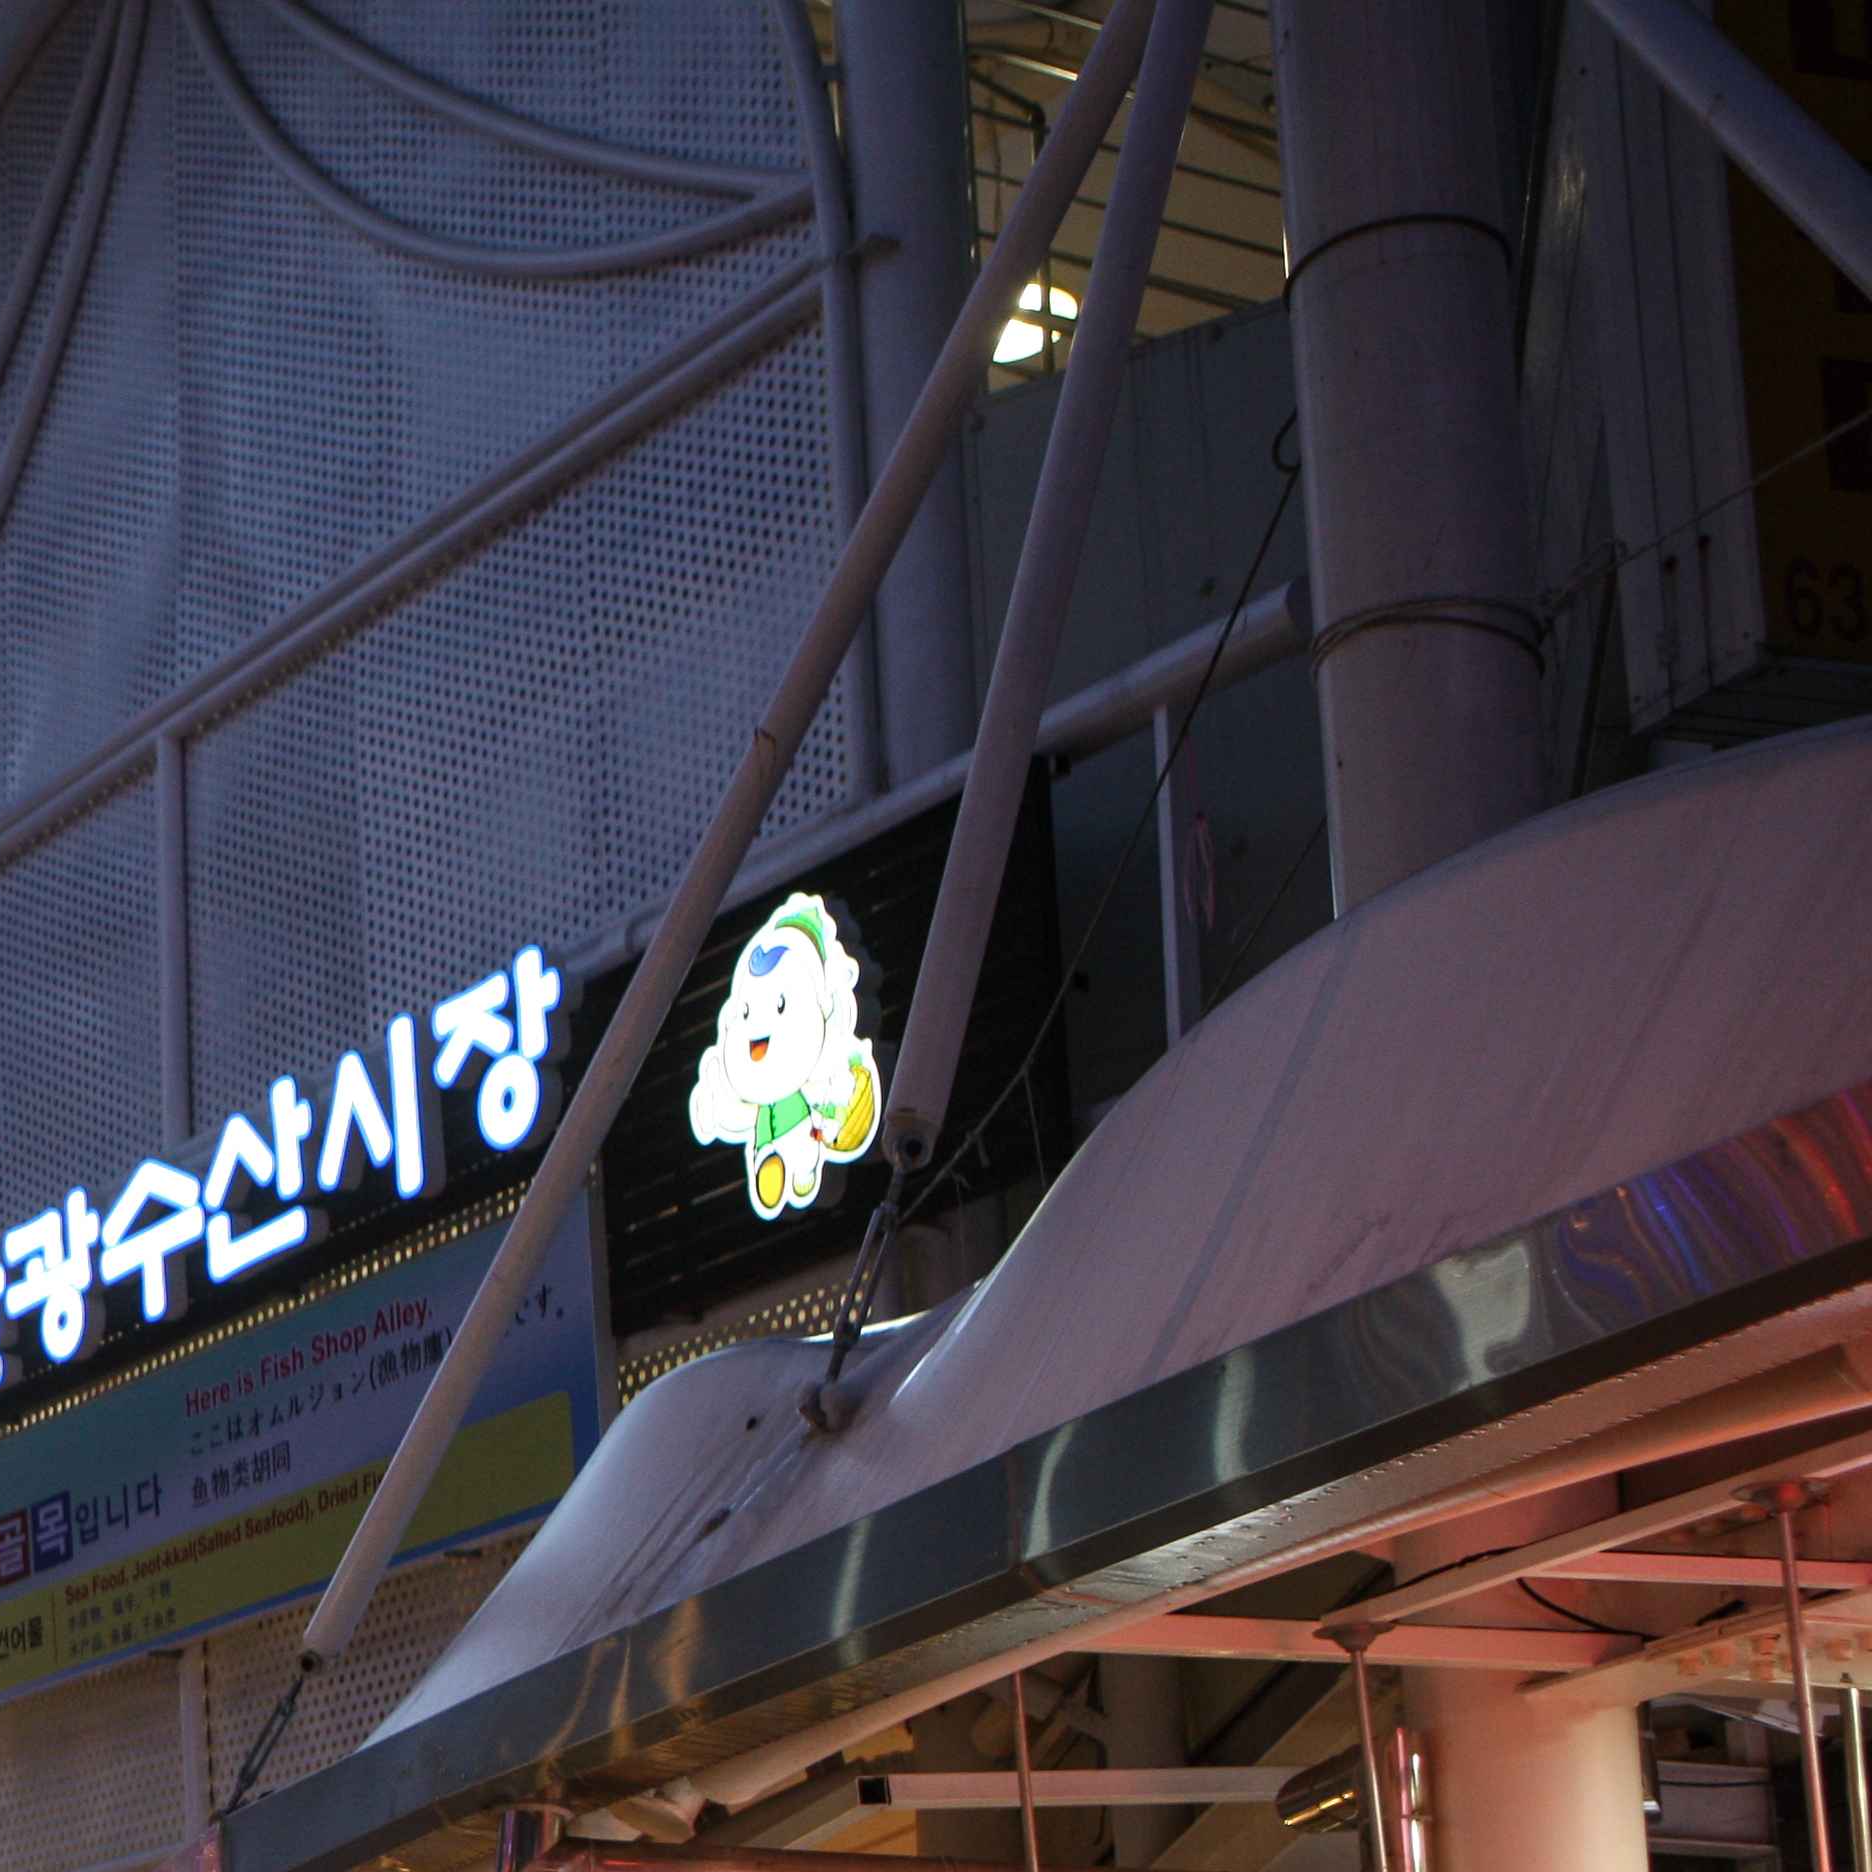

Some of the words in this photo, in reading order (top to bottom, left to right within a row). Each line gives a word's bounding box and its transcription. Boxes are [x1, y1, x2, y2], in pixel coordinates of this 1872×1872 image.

[185, 1382, 231, 1418] Here
[235, 1371, 255, 1399] is
[260, 1347, 306, 1392] Fish
[311, 1328, 365, 1366] Shop
[372, 1299, 433, 1353] Alley.
[65, 1580, 89, 1604] Sea
[318, 1486, 357, 1518] Dried
